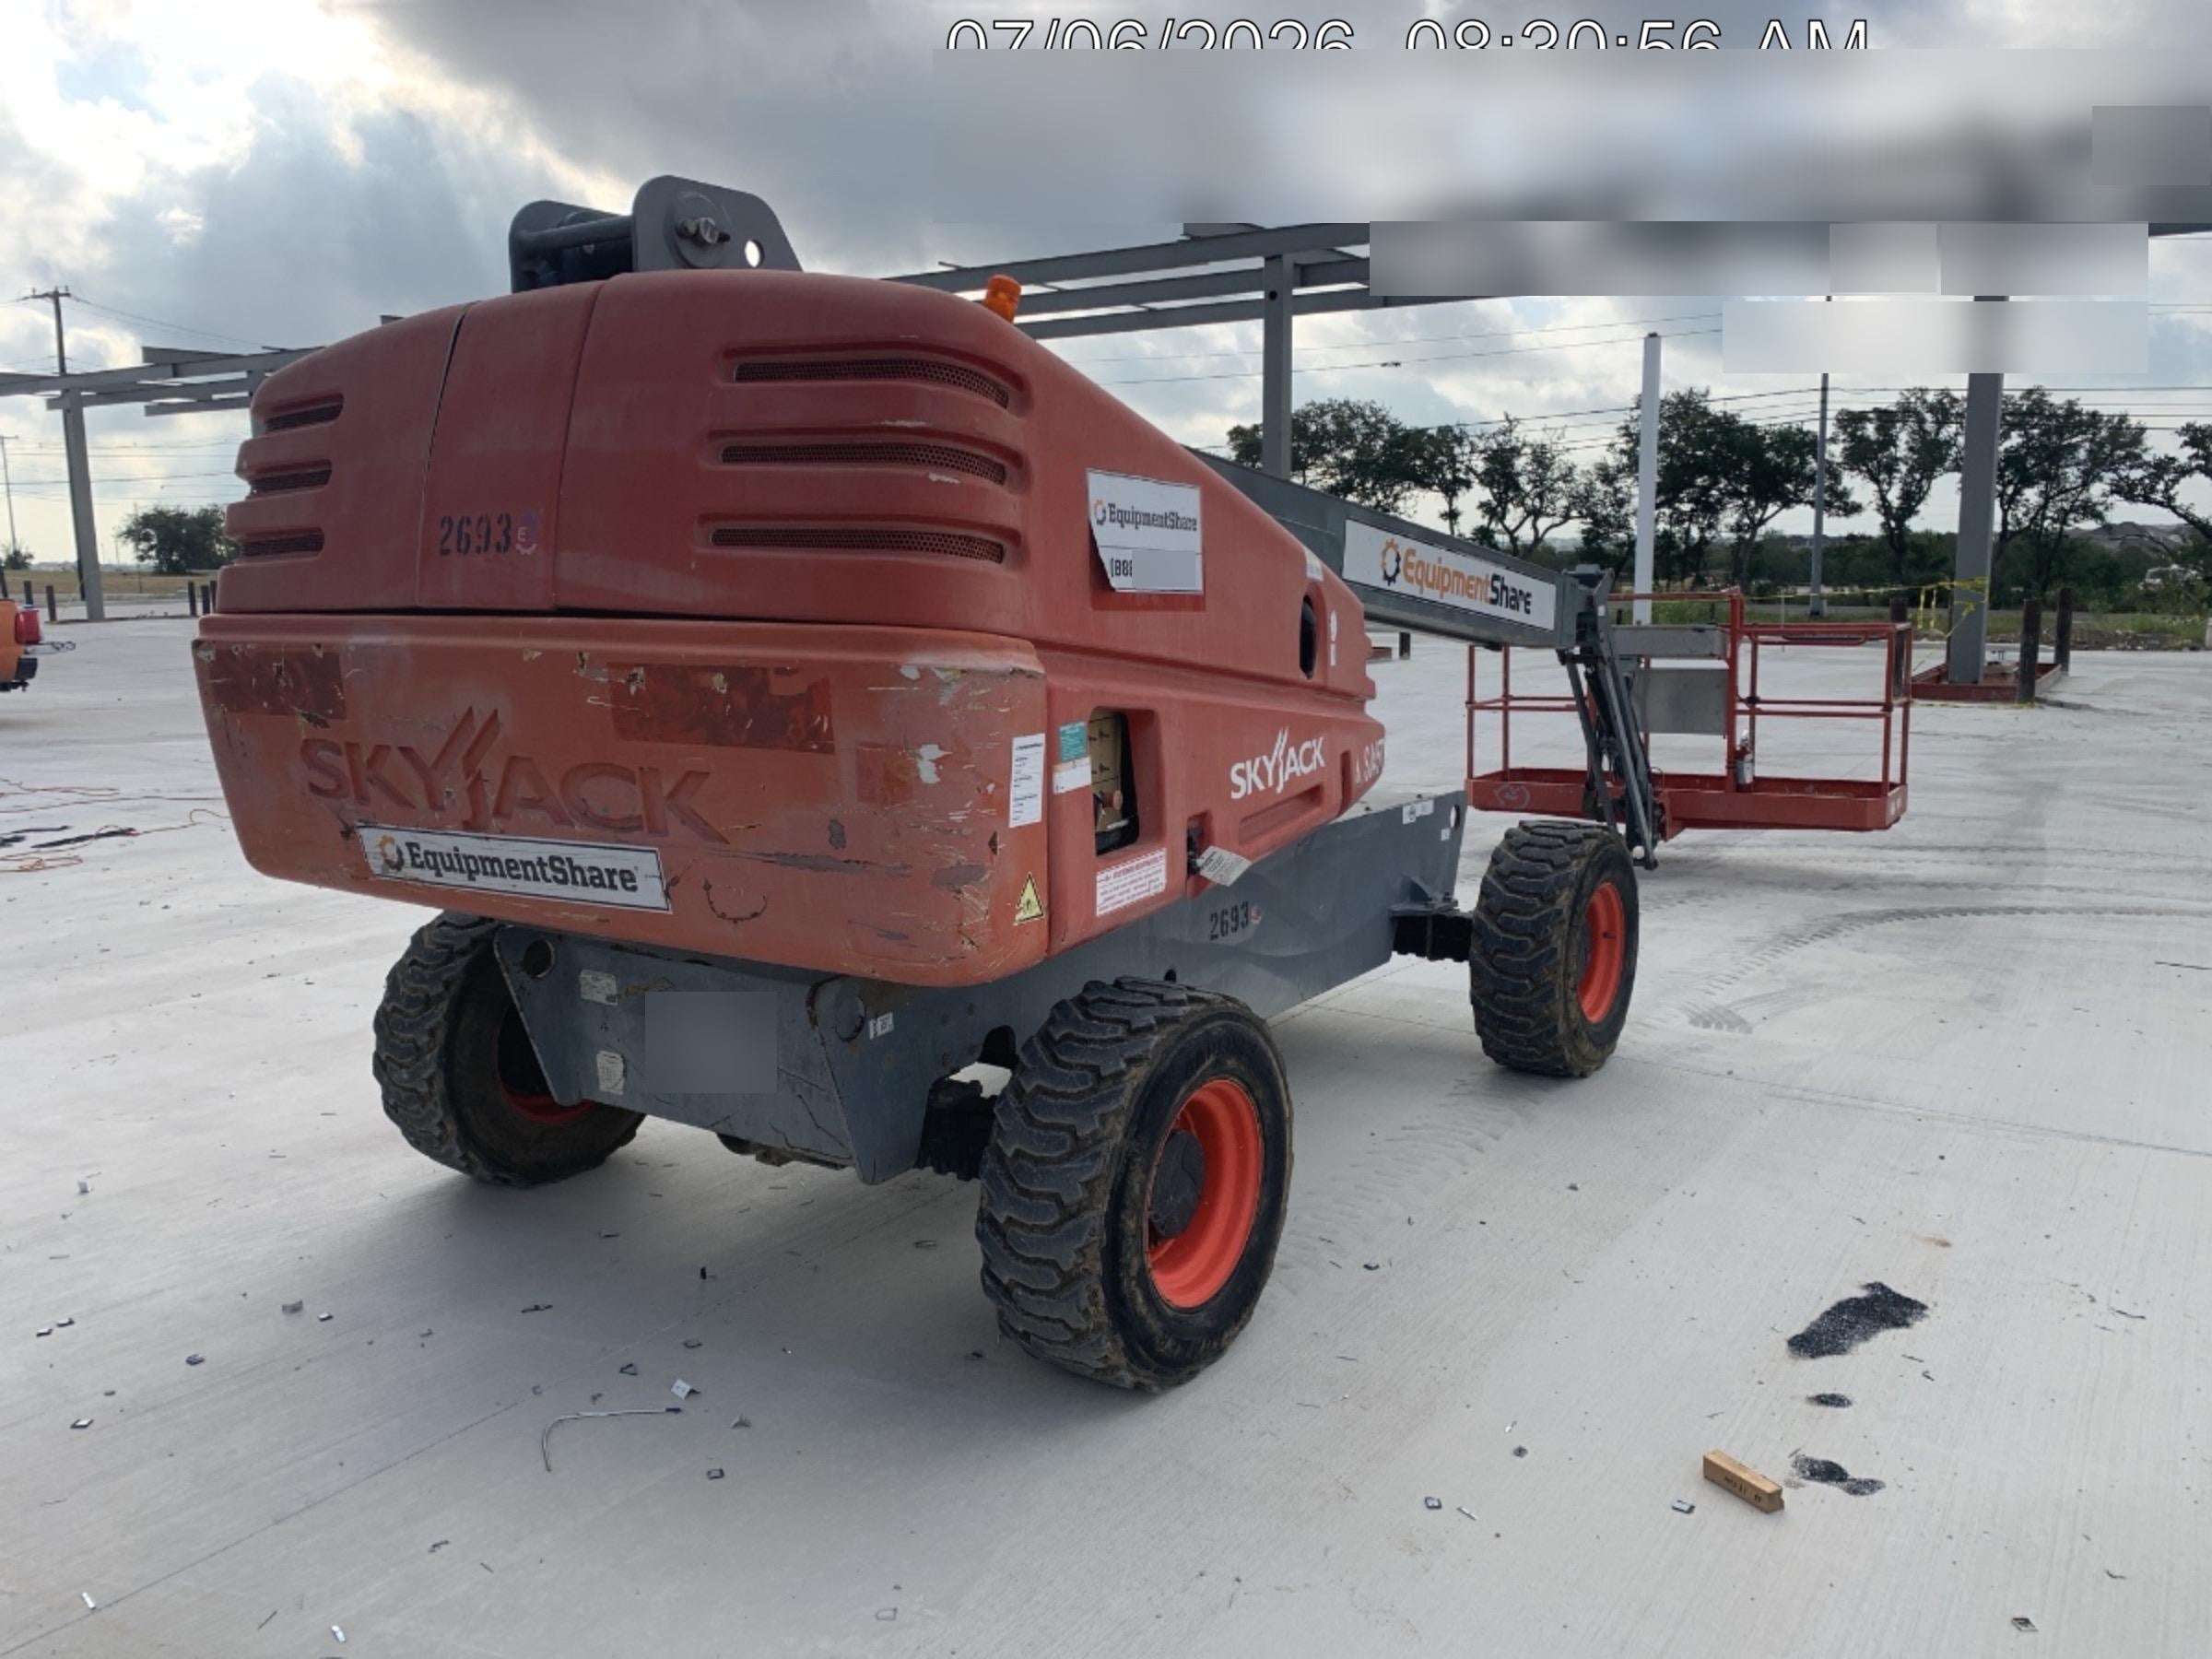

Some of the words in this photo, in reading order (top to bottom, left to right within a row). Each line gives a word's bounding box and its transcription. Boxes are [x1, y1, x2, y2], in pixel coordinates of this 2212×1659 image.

[439, 512, 512, 556] 2693
[1108, 502, 1197, 532] EquipmentShare
[1403, 547, 1532, 615] EquipmentShare
[300, 705, 731, 845] SKYJACK
[1230, 725, 1326, 800] SKYJACK
[405, 841, 638, 893] EquipmentShare
[1209, 900, 1249, 941] 2693
